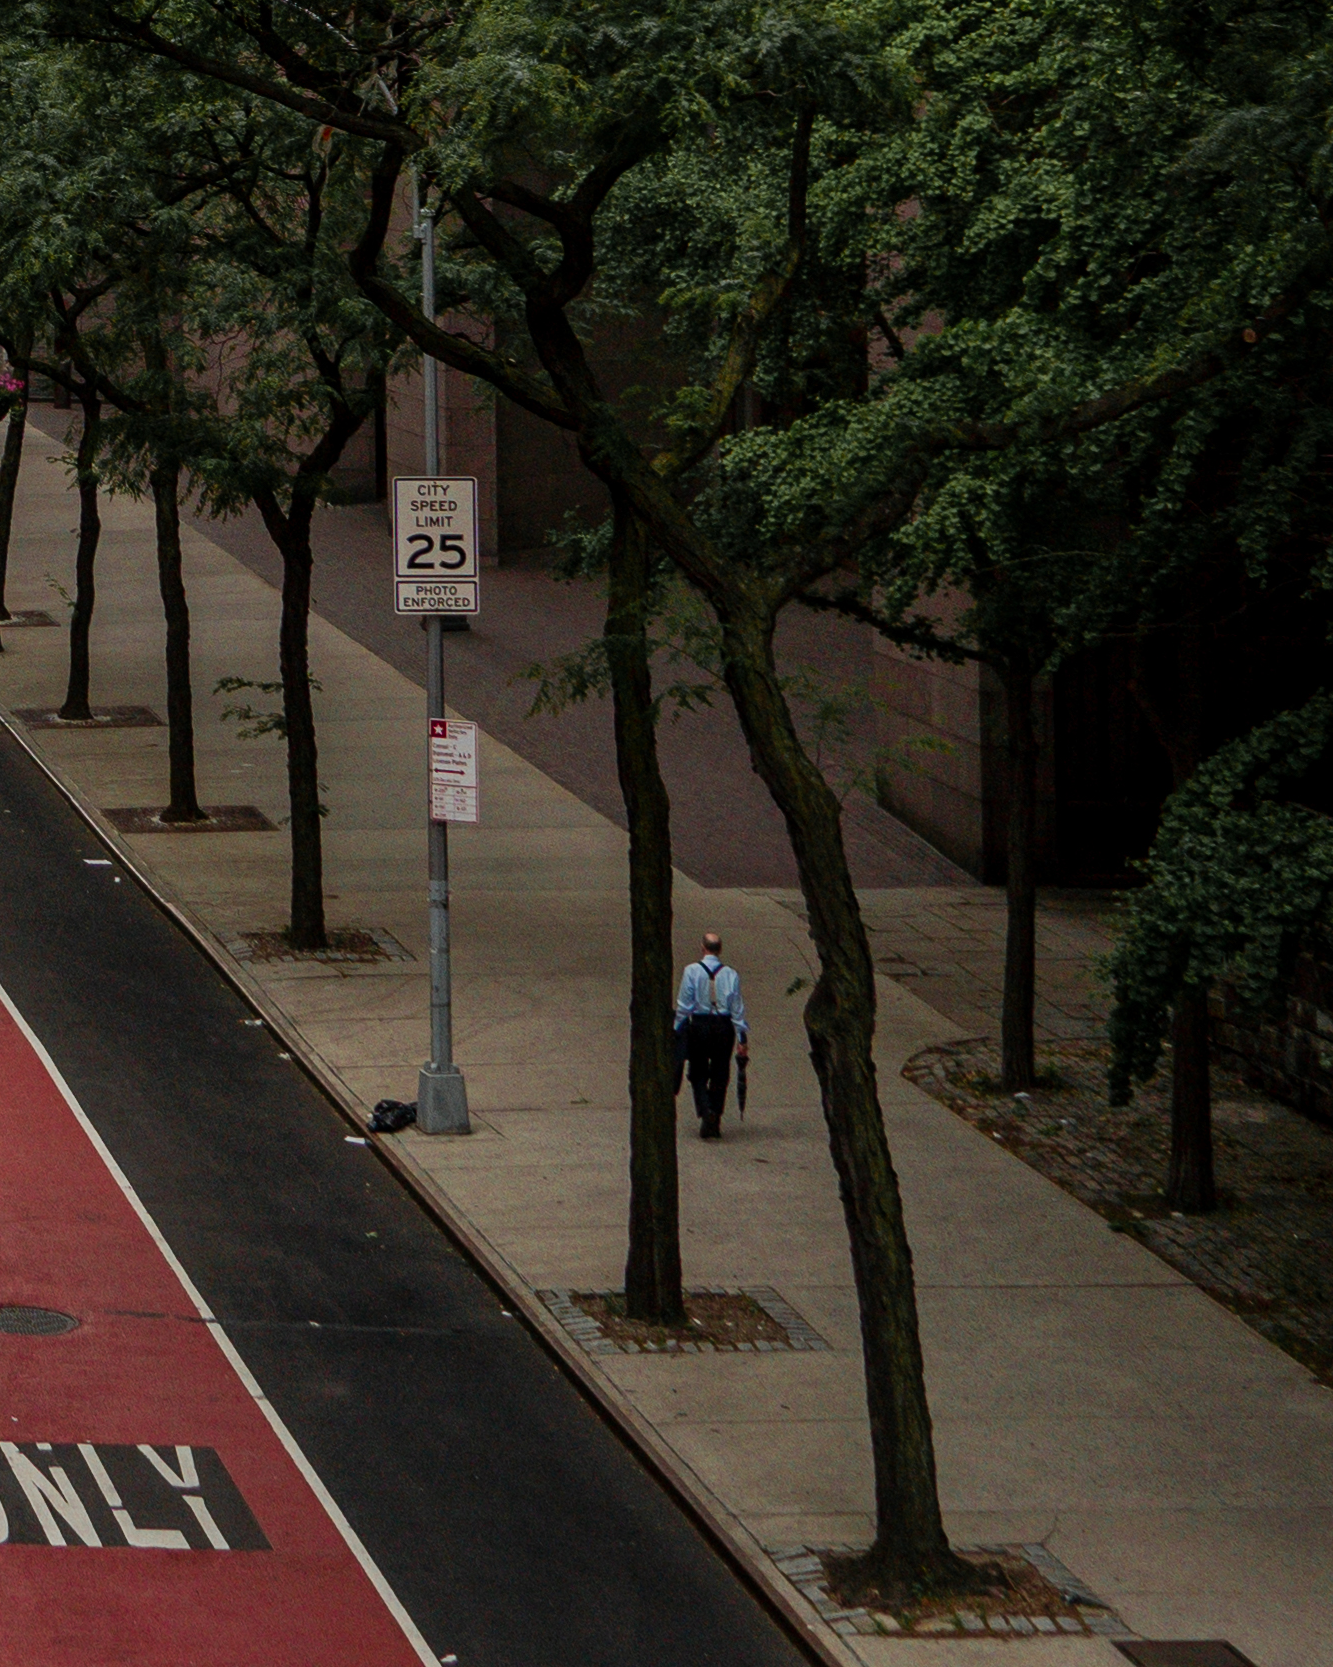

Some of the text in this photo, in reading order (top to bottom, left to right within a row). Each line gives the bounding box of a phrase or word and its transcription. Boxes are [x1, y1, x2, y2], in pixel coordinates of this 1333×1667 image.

[417, 484, 450, 496] CITY
[410, 500, 458, 512] SPEED
[416, 516, 453, 528] LIMIT
[406, 534, 467, 569] 25
[415, 585, 458, 596] PHOTO
[403, 597, 471, 607] ENFORCED
